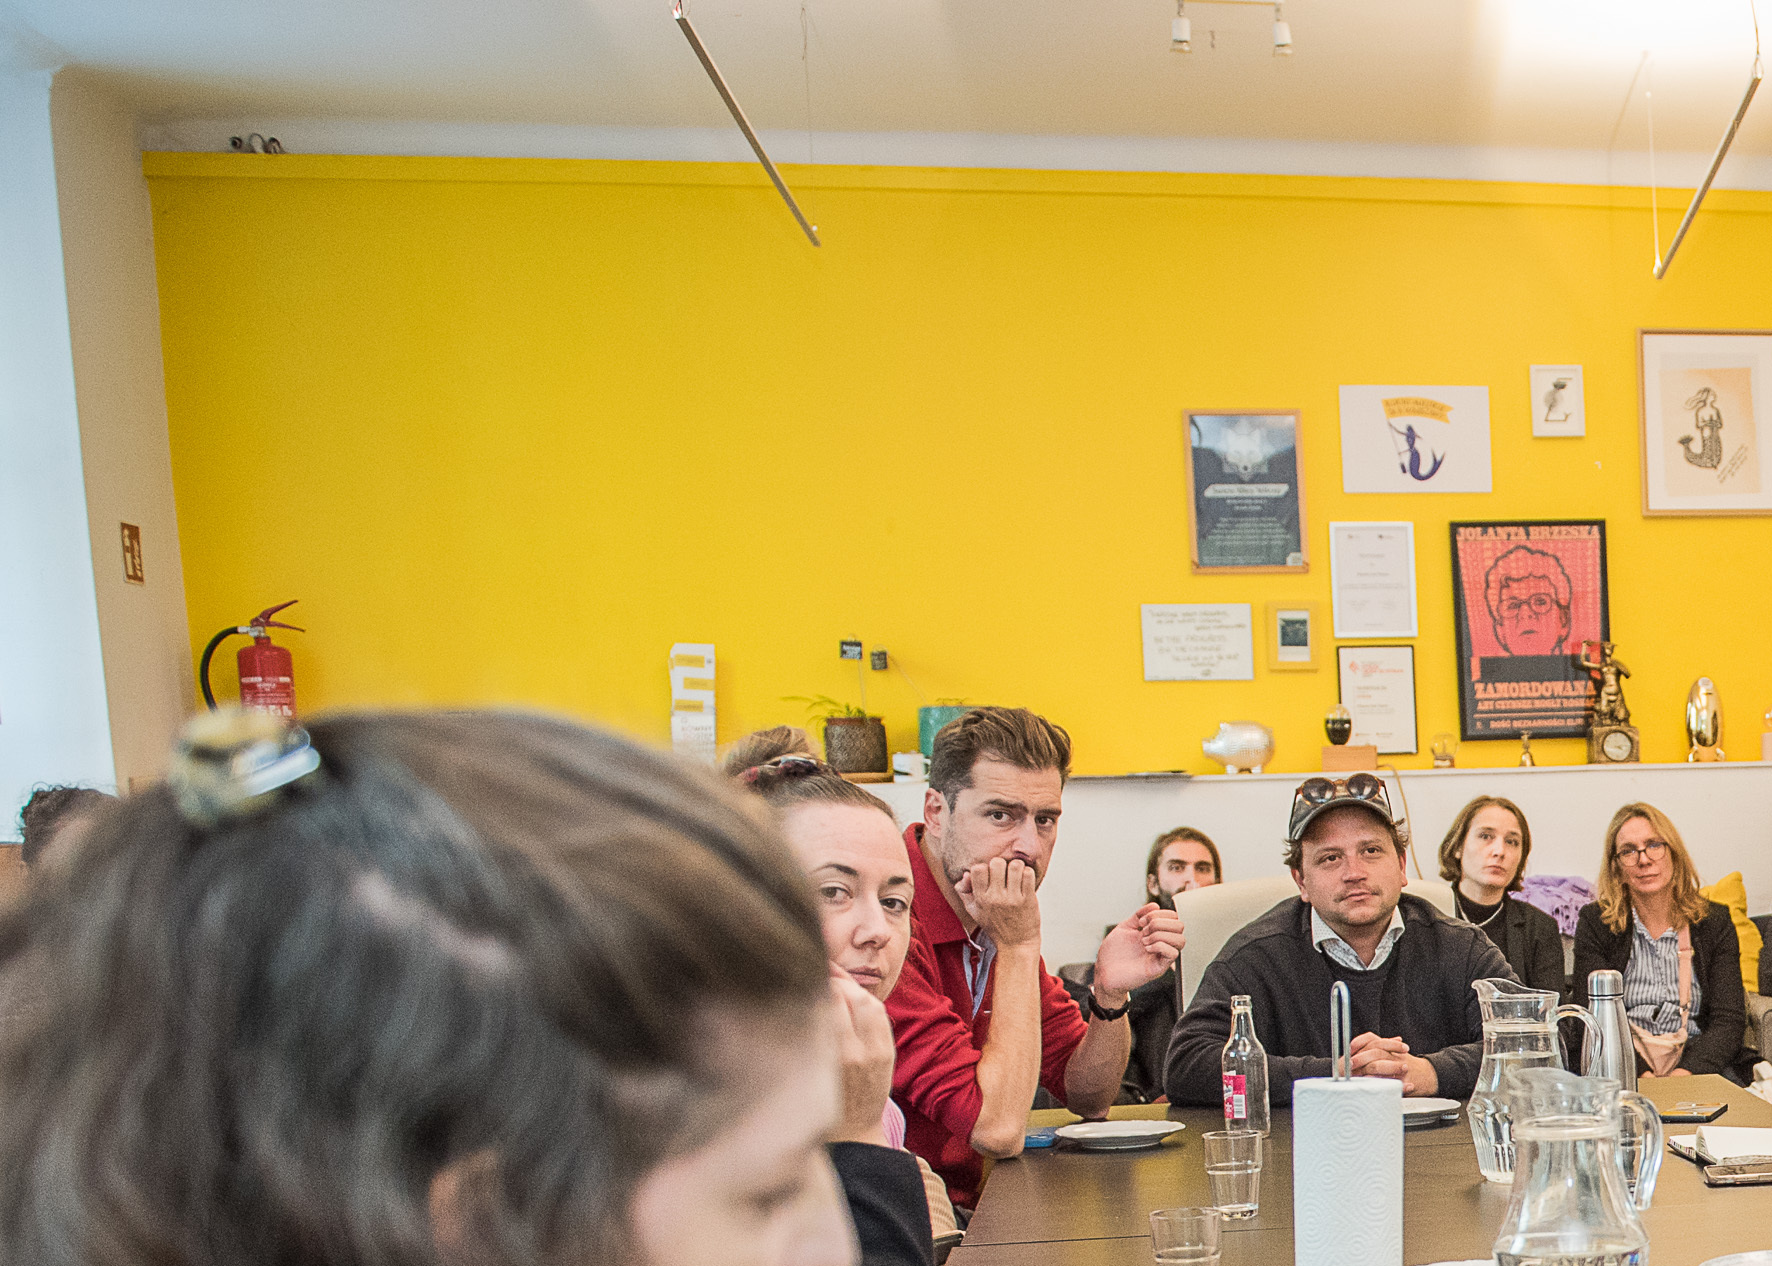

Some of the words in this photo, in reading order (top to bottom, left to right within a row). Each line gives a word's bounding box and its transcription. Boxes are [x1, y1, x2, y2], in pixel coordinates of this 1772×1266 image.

[1457, 526, 1526, 540] JOLANTA
[1528, 525, 1600, 540] BRZESKA
[1474, 680, 1597, 698] ZAMORDOWANA
